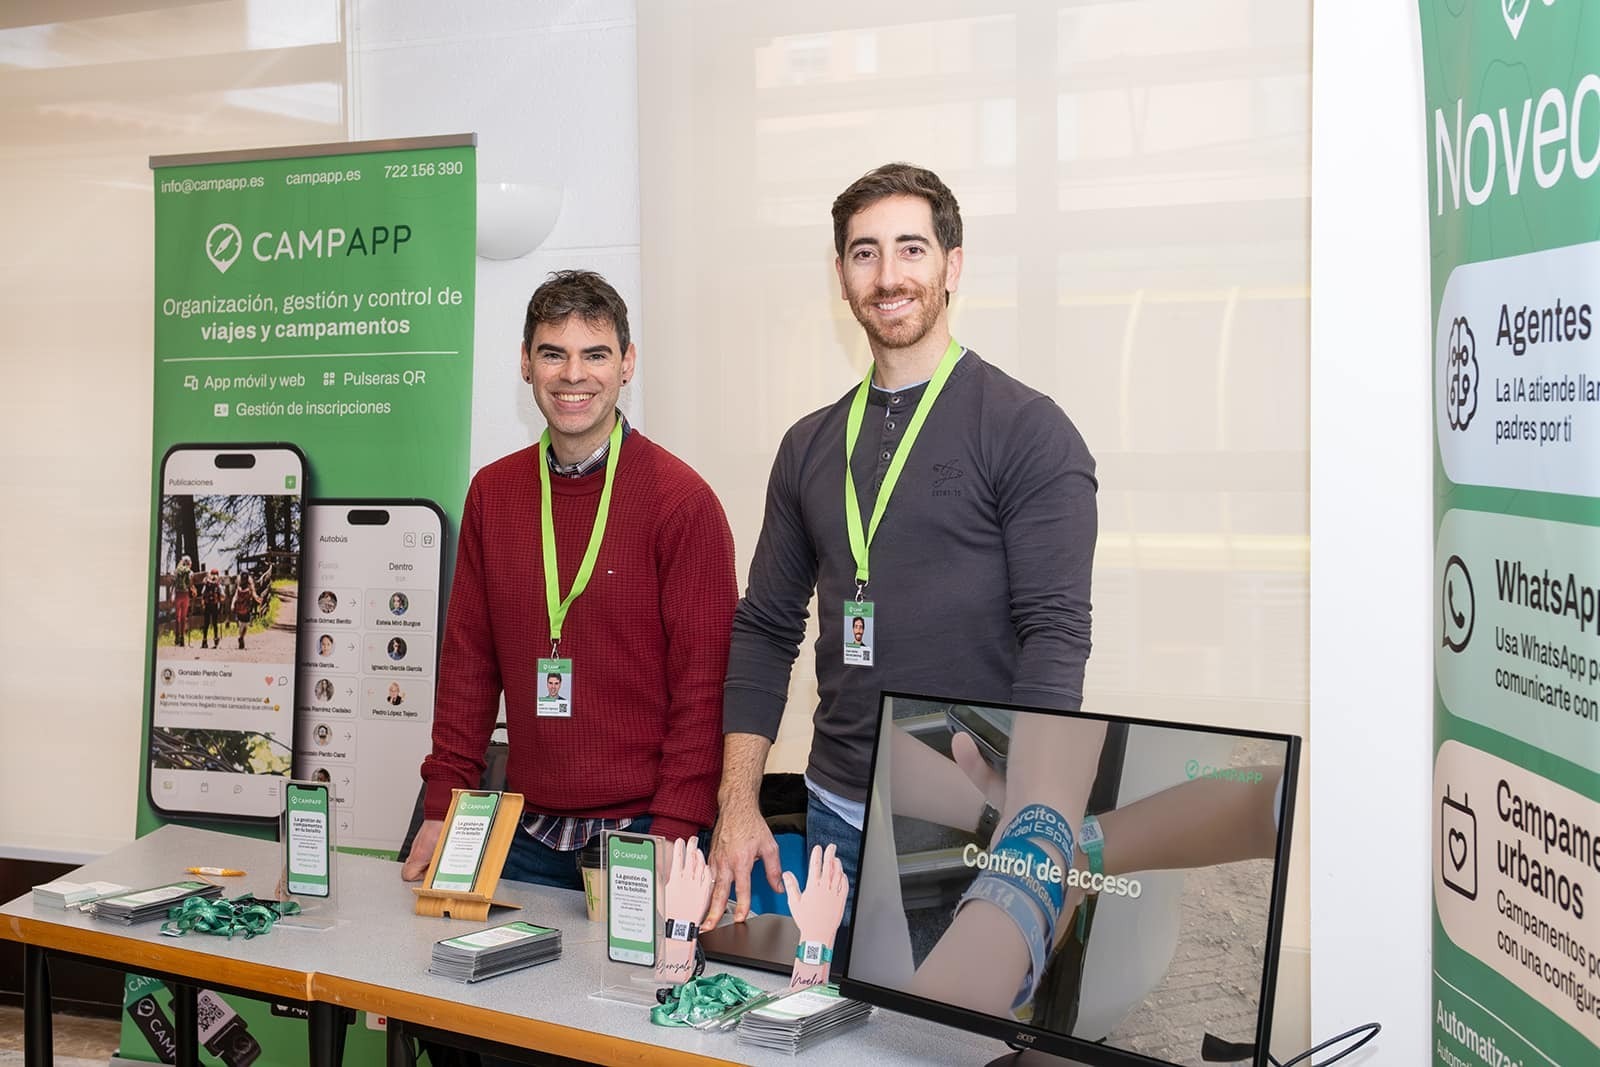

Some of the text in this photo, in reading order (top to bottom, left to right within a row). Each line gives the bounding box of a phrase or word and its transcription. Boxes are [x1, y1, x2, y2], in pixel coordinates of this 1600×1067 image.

[286, 170, 361, 186] campapp.es
[384, 161, 463, 178] 722 156 390
[161, 176, 264, 194] info@campapp.es
[252, 224, 412, 262] CAMPAPP
[163, 286, 463, 318] Organización, gestión y control de
[201, 317, 410, 343] viajes y campamentos
[1496, 298, 1592, 356] Agentes
[204, 372, 306, 391] App móvil y web
[344, 370, 426, 386] Pulseras QR
[1496, 378, 1511, 402] La
[1514, 377, 1526, 402] IA
[1529, 374, 1575, 402] atiende
[236, 399, 391, 416] Gestión de inscripciones
[1496, 414, 1572, 447] padres por ti
[169, 479, 213, 487] Publicaciones
[319, 535, 348, 543] Autobús
[389, 562, 413, 571] Dentro
[1496, 626, 1600, 685] Usa WhatsApp p
[1495, 668, 1598, 722] comunicarte con
[1202, 765, 1263, 784] CAMPAPP
[962, 843, 1142, 898] Control de acceso
[1497, 839, 1584, 920] urbanos
[1496, 889, 1586, 967] Campamentos
[1497, 930, 1519, 960] con
[1520, 945, 1542, 978] una
[128, 976, 160, 992] CAM
[791, 971, 825, 988] Noelia
[1016, 1031, 1037, 1043] acer
